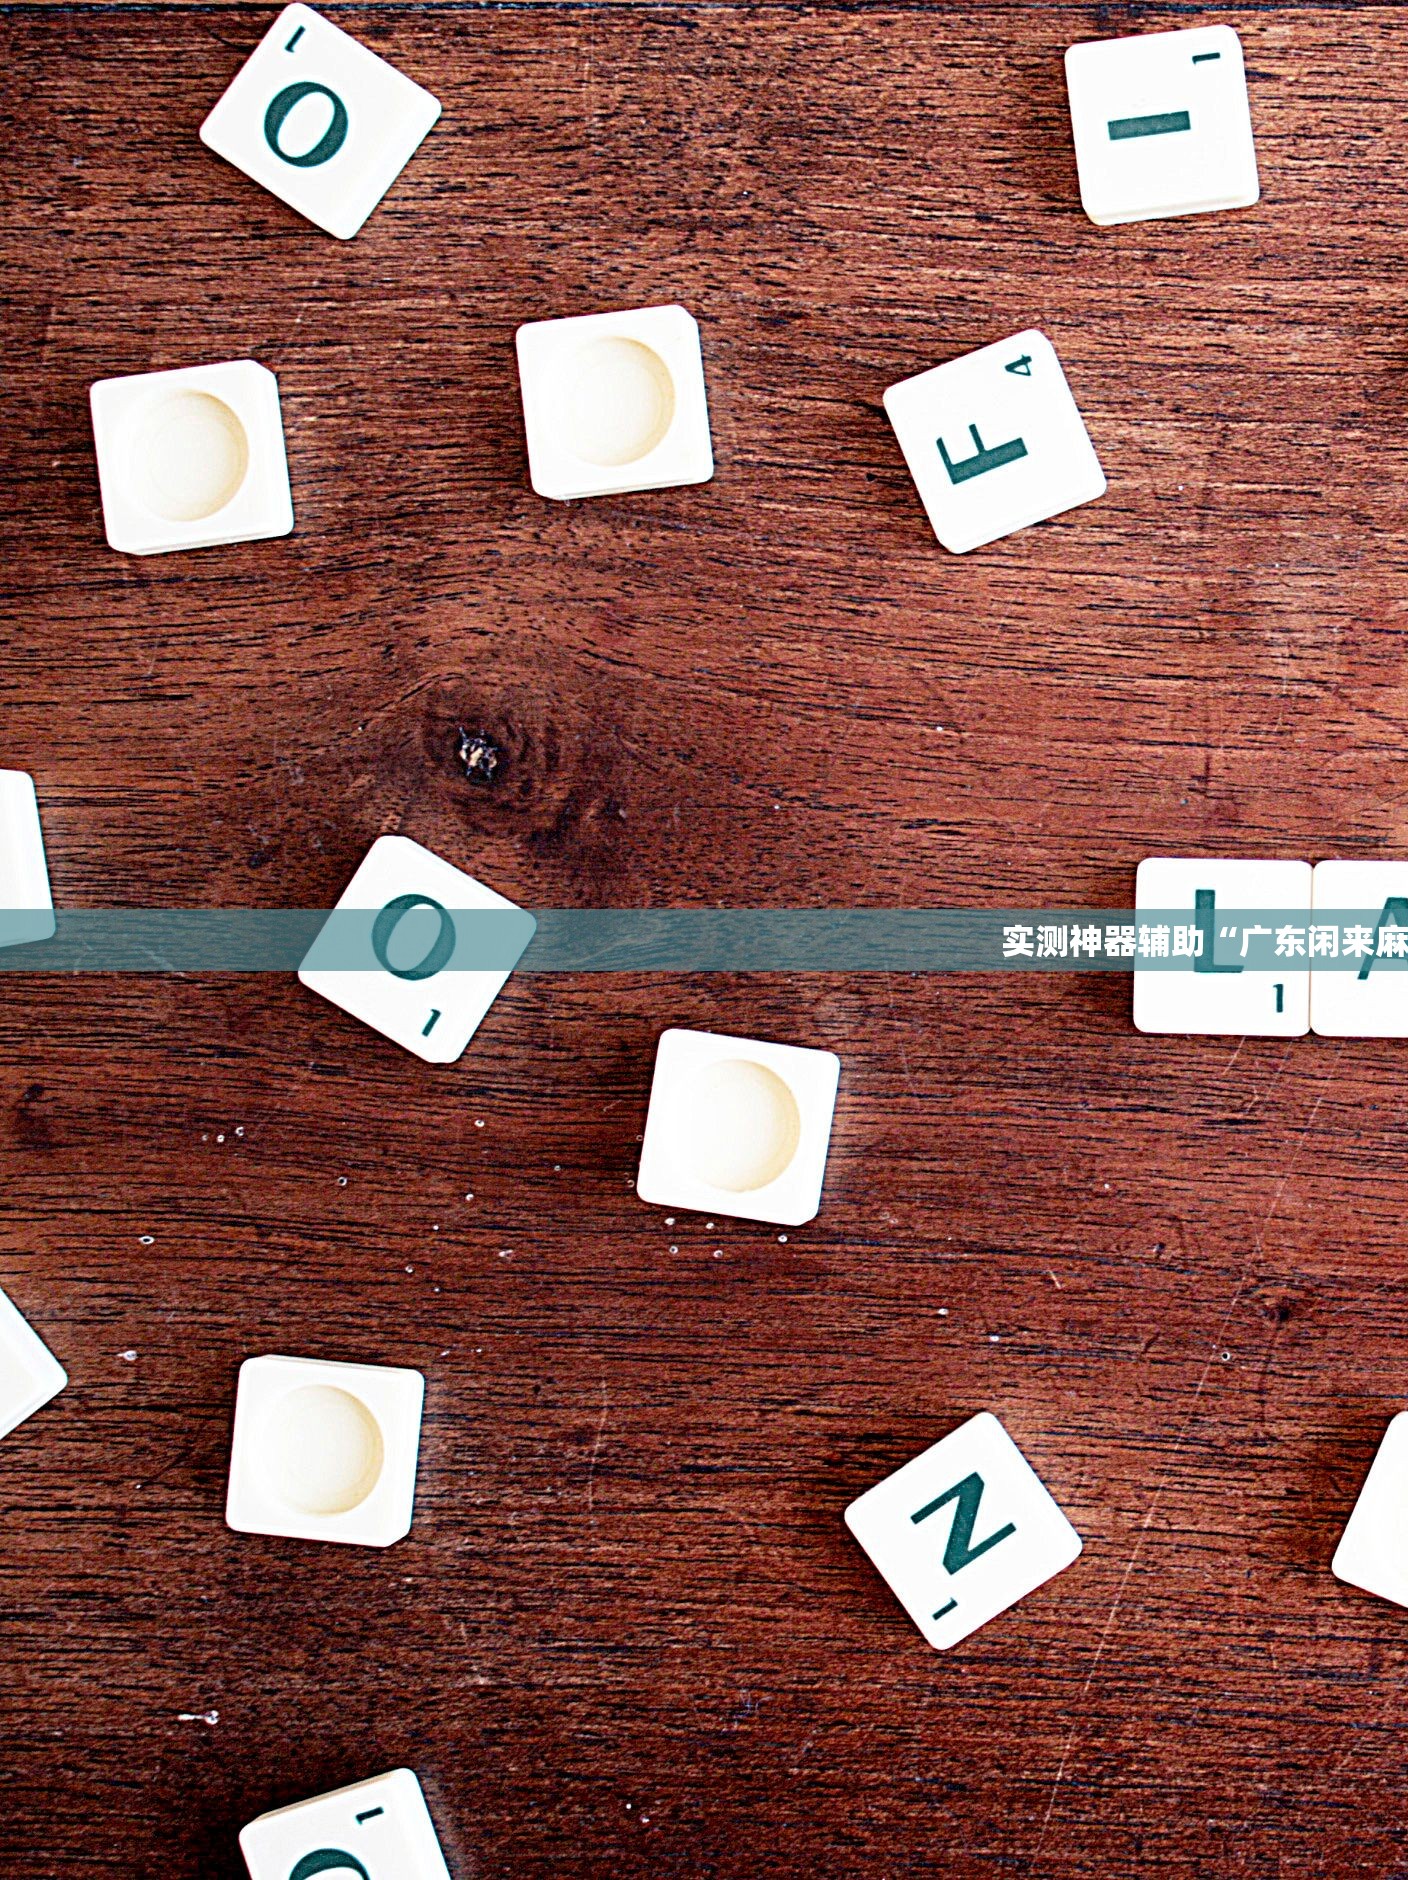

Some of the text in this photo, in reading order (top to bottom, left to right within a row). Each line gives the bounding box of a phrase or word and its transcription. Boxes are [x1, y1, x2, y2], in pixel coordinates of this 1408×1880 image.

[285, 26, 307, 54] 1
[1192, 53, 1222, 66] 1
[264, 81, 350, 170] O
[1108, 111, 1193, 142] I
[1005, 355, 1034, 378] 4
[936, 424, 1030, 486] F
[370, 893, 458, 982] O
[1272, 983, 1285, 1014] 1
[420, 1007, 443, 1039] 1
[911, 1472, 1018, 1577] N
[933, 1599, 959, 1622] 1
[356, 1807, 386, 1826] 1
